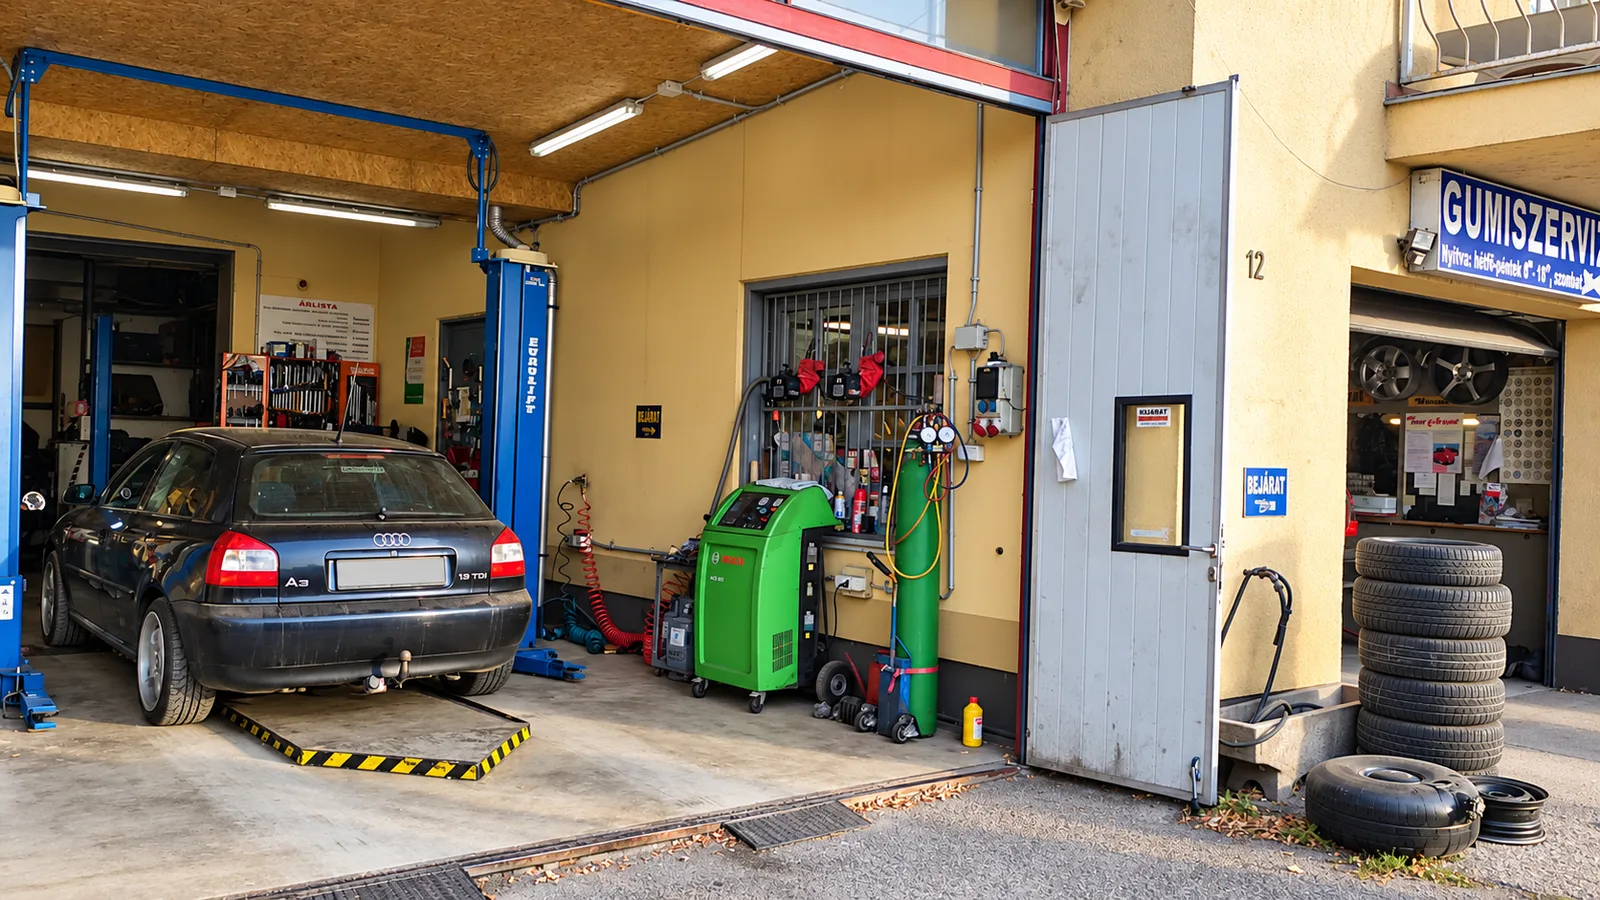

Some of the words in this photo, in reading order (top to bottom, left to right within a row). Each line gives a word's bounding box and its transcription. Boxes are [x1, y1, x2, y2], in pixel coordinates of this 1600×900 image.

[1246, 249, 1264, 280] 12
[1441, 243, 1472, 268] Nyitva:
[525, 337, 539, 414] EUROLIFT
[1247, 470, 1286, 495] BEJÁRAT
[284, 576, 309, 588] A3
[471, 572, 488, 580] TDI
